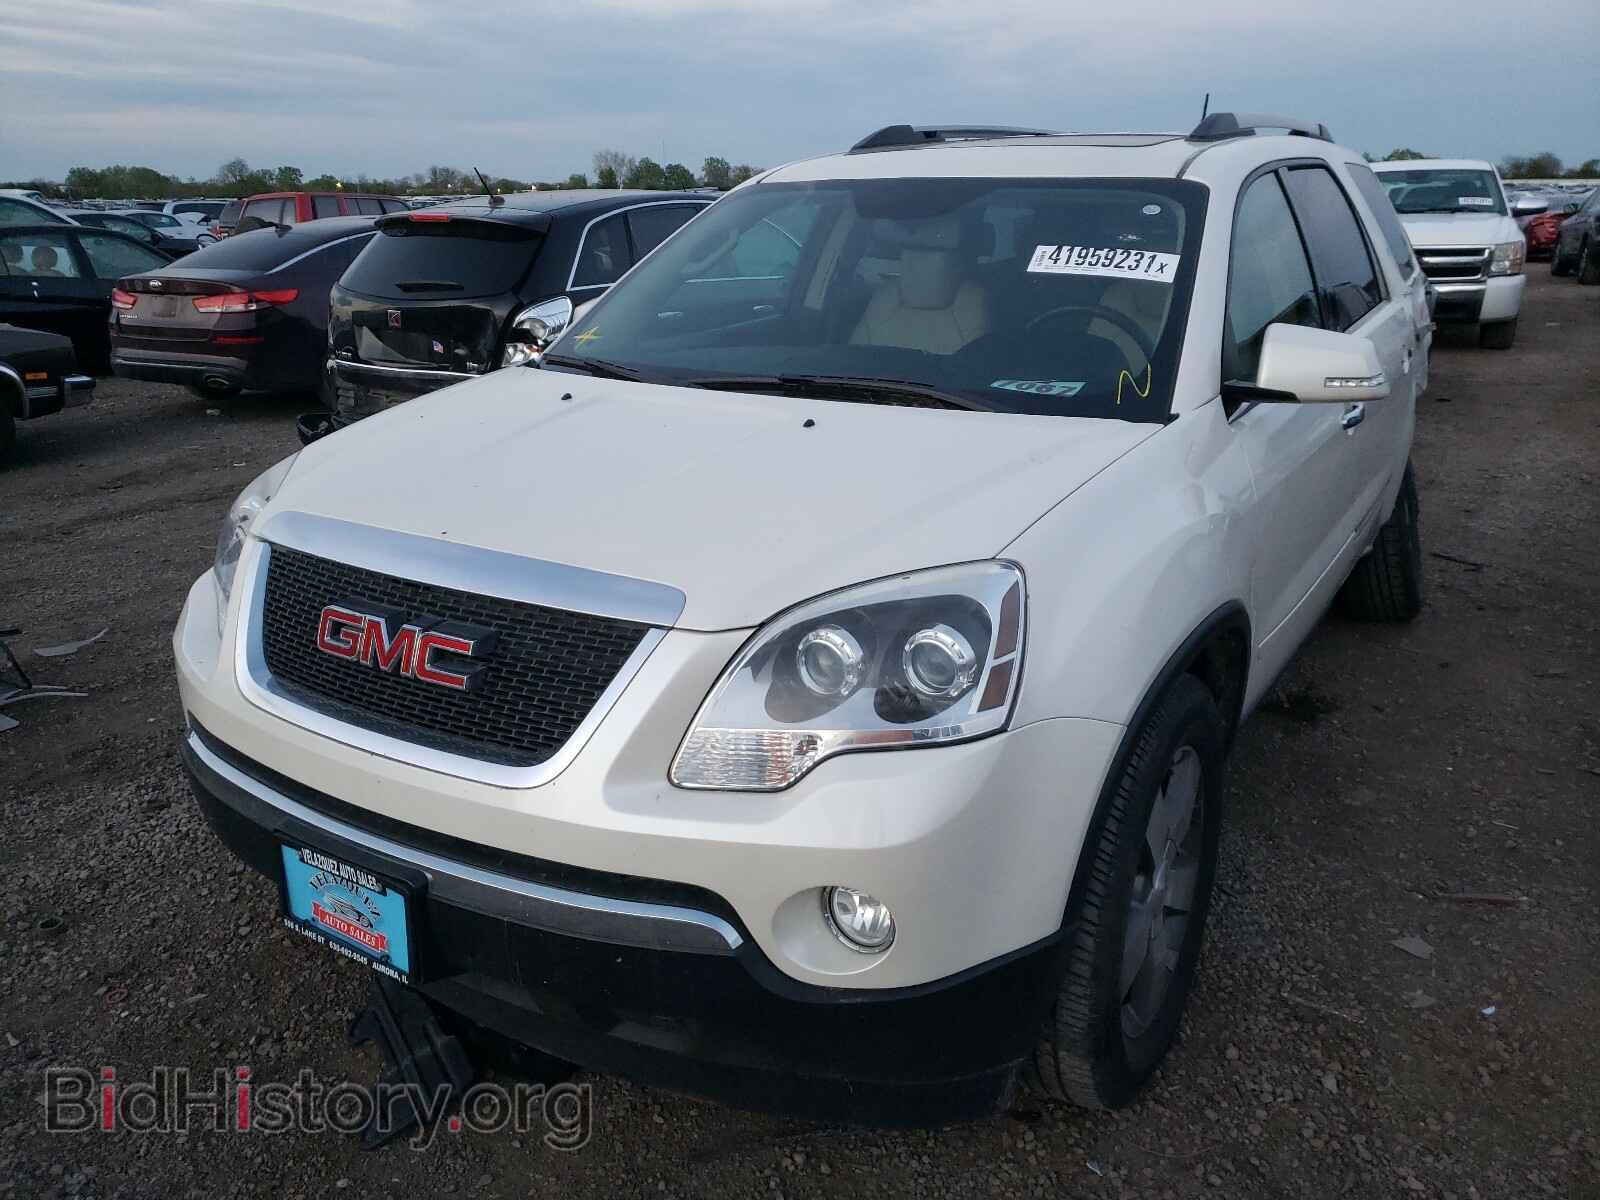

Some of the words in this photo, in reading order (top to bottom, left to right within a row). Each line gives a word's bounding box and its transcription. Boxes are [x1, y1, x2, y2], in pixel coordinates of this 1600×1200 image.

[1048, 245, 1157, 273] 41959231
[317, 605, 475, 690] GMC
[301, 847, 339, 876] VELAZQUEZ
[339, 862, 356, 882] AUTO
[356, 870, 377, 890] SALES
[301, 927, 317, 941] LAKE
[323, 914, 348, 933] AUTO
[349, 925, 376, 947] SALES
